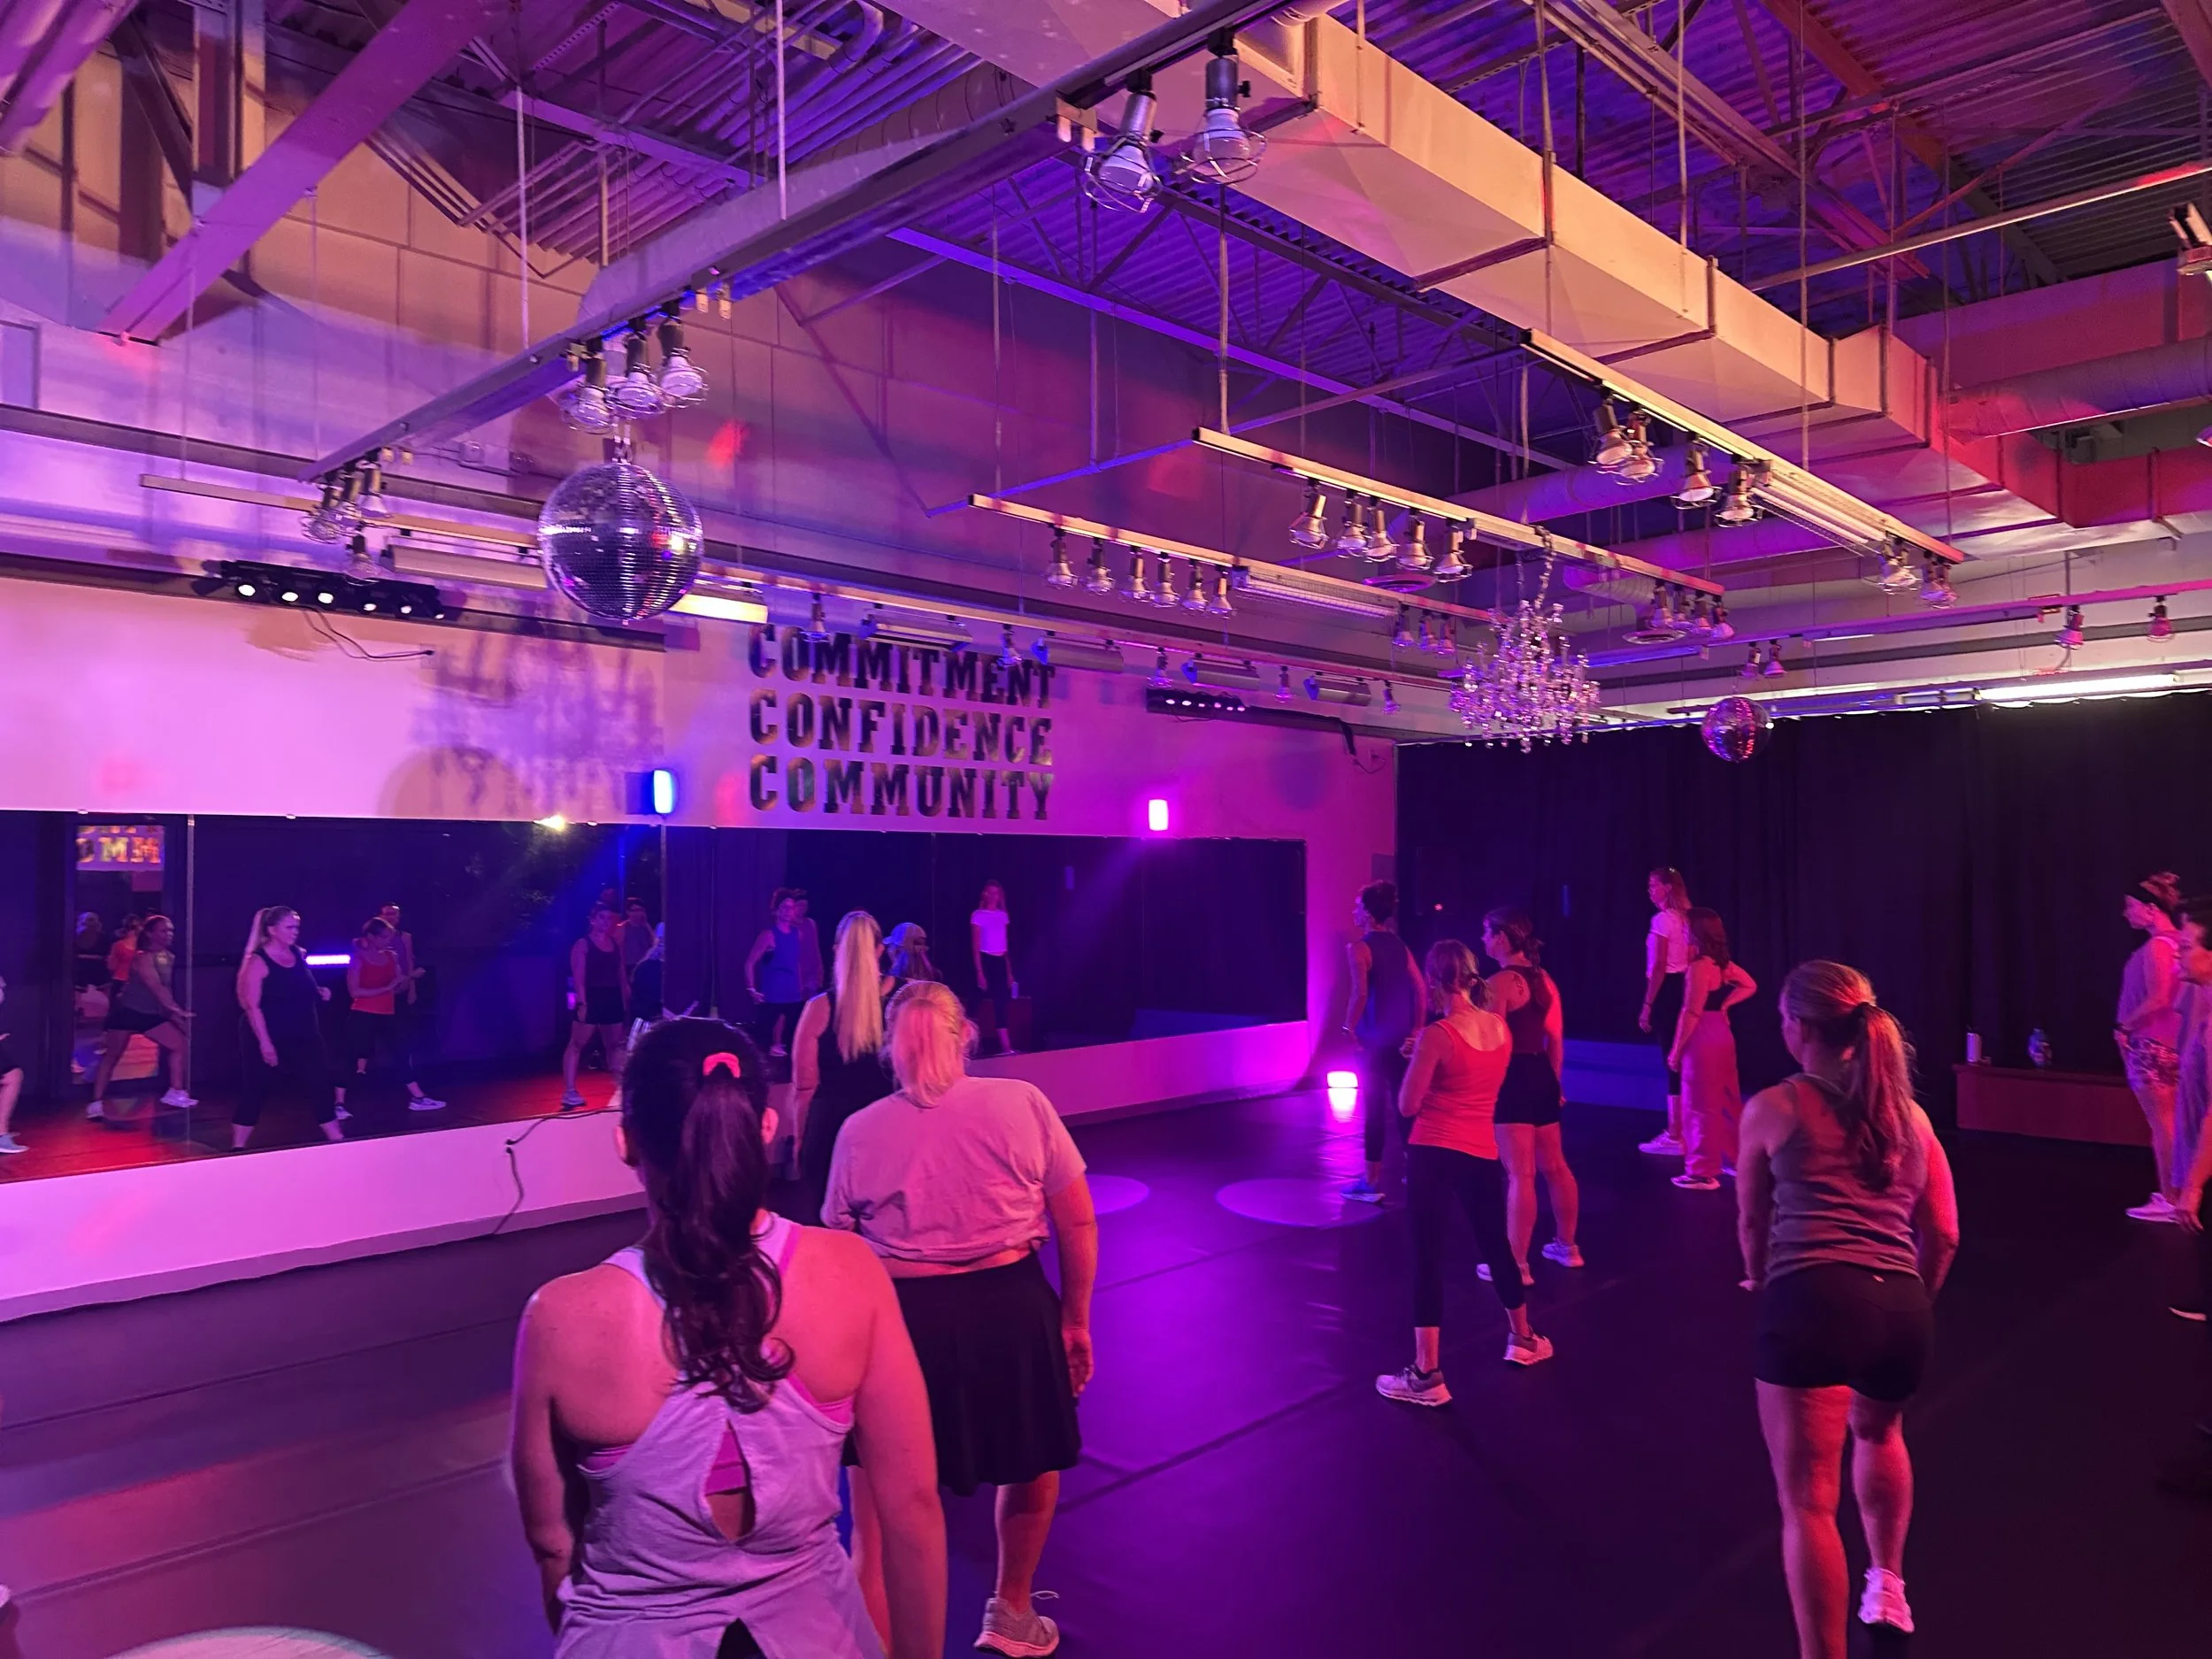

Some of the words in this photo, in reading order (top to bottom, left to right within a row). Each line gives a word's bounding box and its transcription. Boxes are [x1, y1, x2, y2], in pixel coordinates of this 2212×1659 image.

[749, 626, 1056, 709] COMMITMENT
[749, 688, 1053, 766] CONFIDENCE
[749, 753, 1055, 820] COMMUNITY
